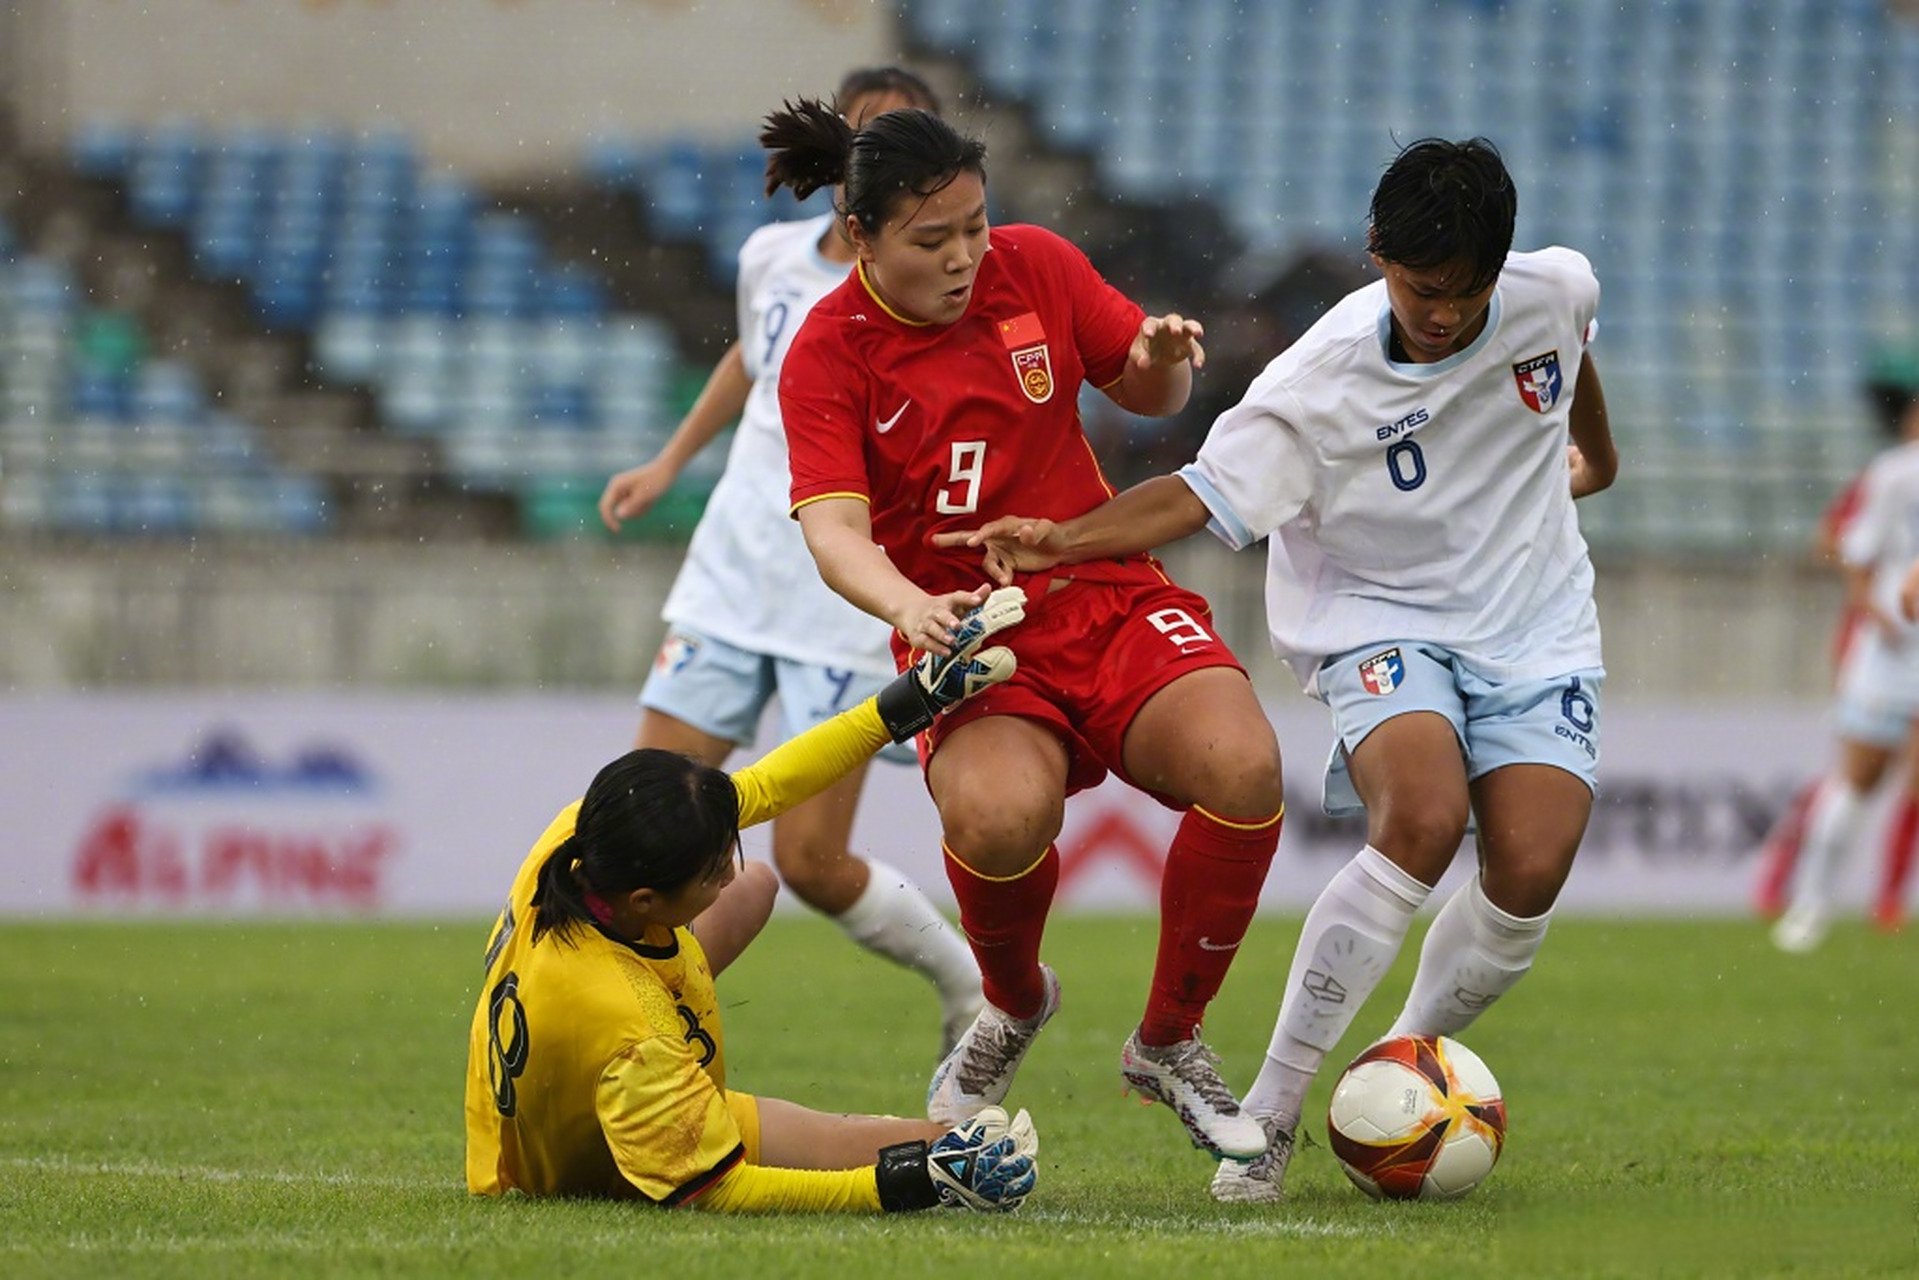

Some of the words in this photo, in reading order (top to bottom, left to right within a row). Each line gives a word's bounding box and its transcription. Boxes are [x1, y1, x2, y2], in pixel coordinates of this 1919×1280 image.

[763, 303, 789, 364] 9
[1376, 407, 1430, 441] ENTES
[934, 440, 986, 515] 9
[1145, 608, 1214, 646] 9
